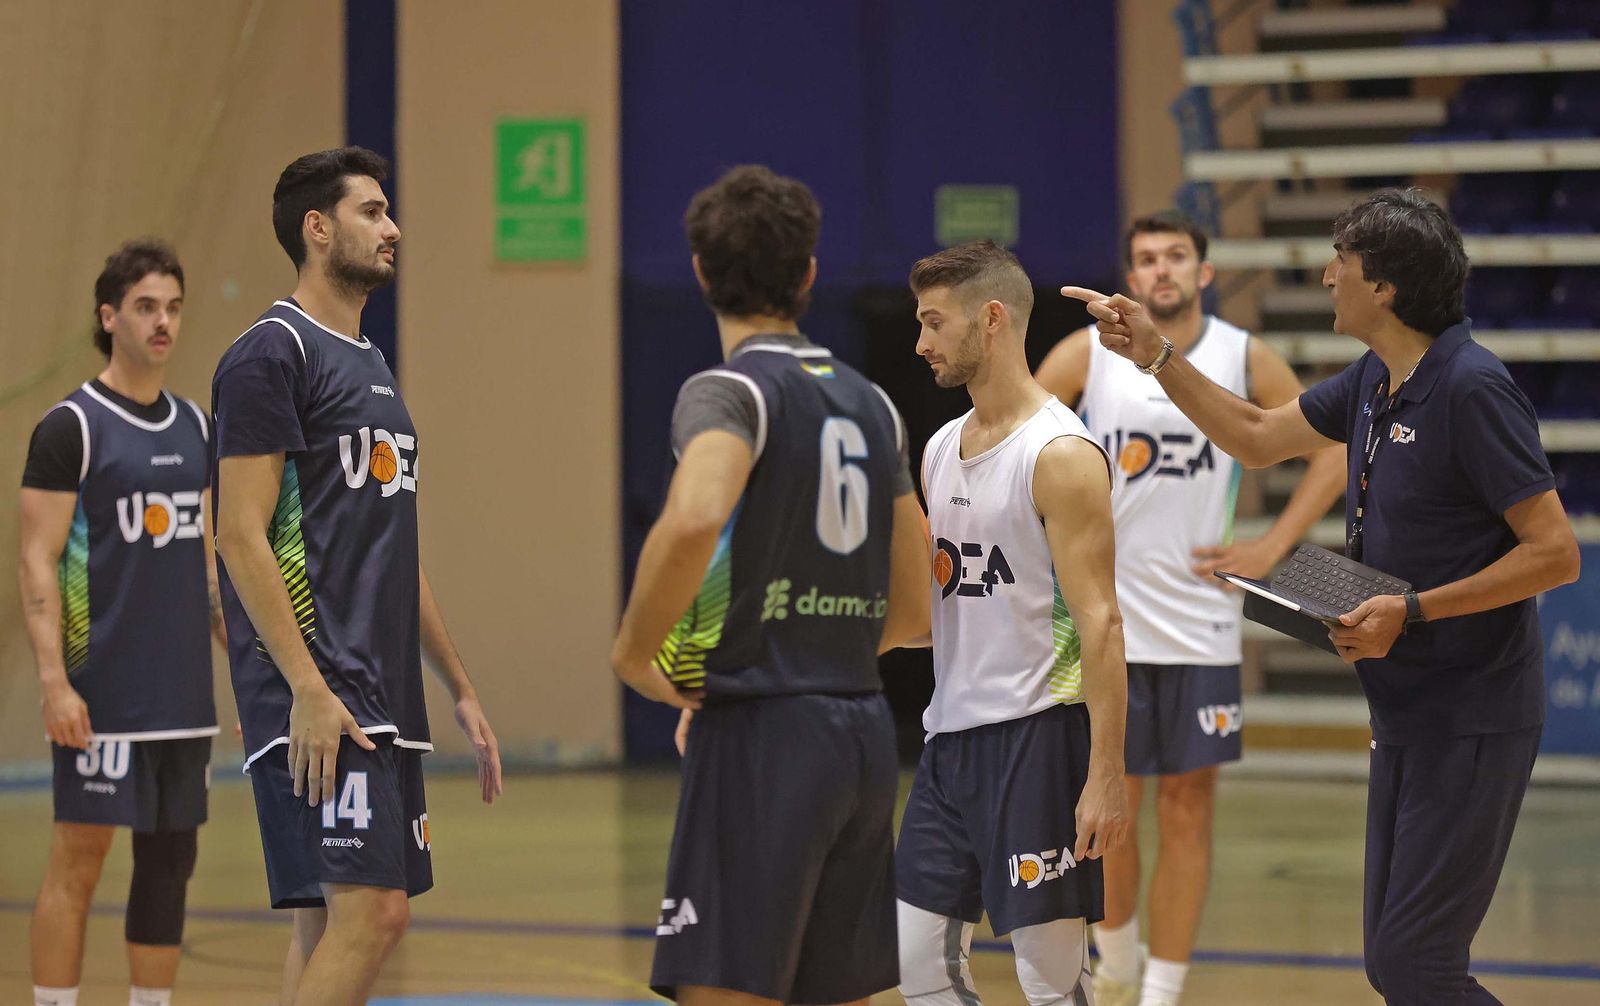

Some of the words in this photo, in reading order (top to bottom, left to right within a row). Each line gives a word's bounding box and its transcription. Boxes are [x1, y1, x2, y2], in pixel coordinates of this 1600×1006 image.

[1389, 422, 1416, 444] UDEA
[816, 416, 869, 555] 6
[116, 491, 205, 549] UDE
[932, 535, 1015, 600] DEA
[1009, 846, 1077, 889] UDEA
